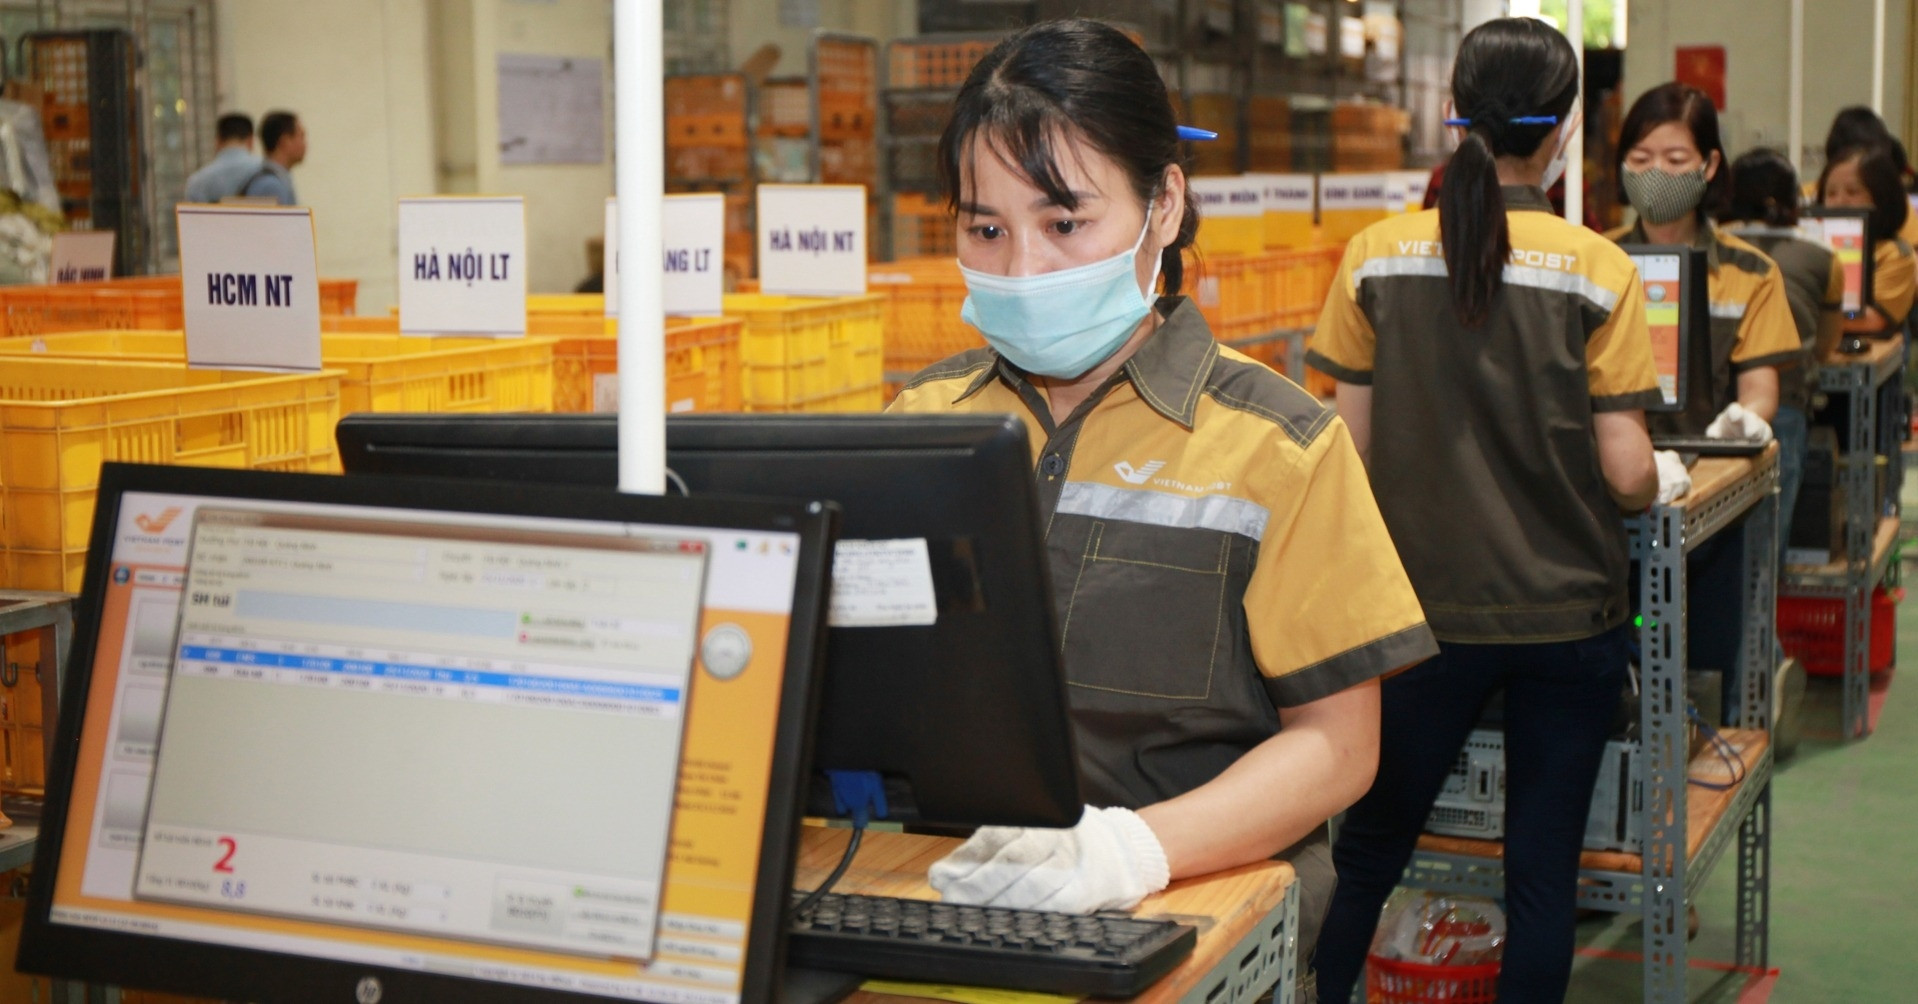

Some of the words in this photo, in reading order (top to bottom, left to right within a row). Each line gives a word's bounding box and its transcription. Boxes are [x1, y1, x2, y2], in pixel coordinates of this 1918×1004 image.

[769, 224, 792, 251] HÀ
[798, 225, 827, 258] NỘI
[833, 230, 854, 251] NT
[1398, 240, 1443, 256] VIET
[1510, 248, 1576, 271] POST
[414, 247, 441, 280] HÀ
[448, 247, 483, 287] NỘI
[490, 253, 510, 280] LT
[695, 249, 711, 272] LT
[207, 273, 258, 306] HCM
[265, 275, 293, 307] NT
[1153, 477, 1204, 494] VIETNAM
[212, 837, 237, 874] 2
